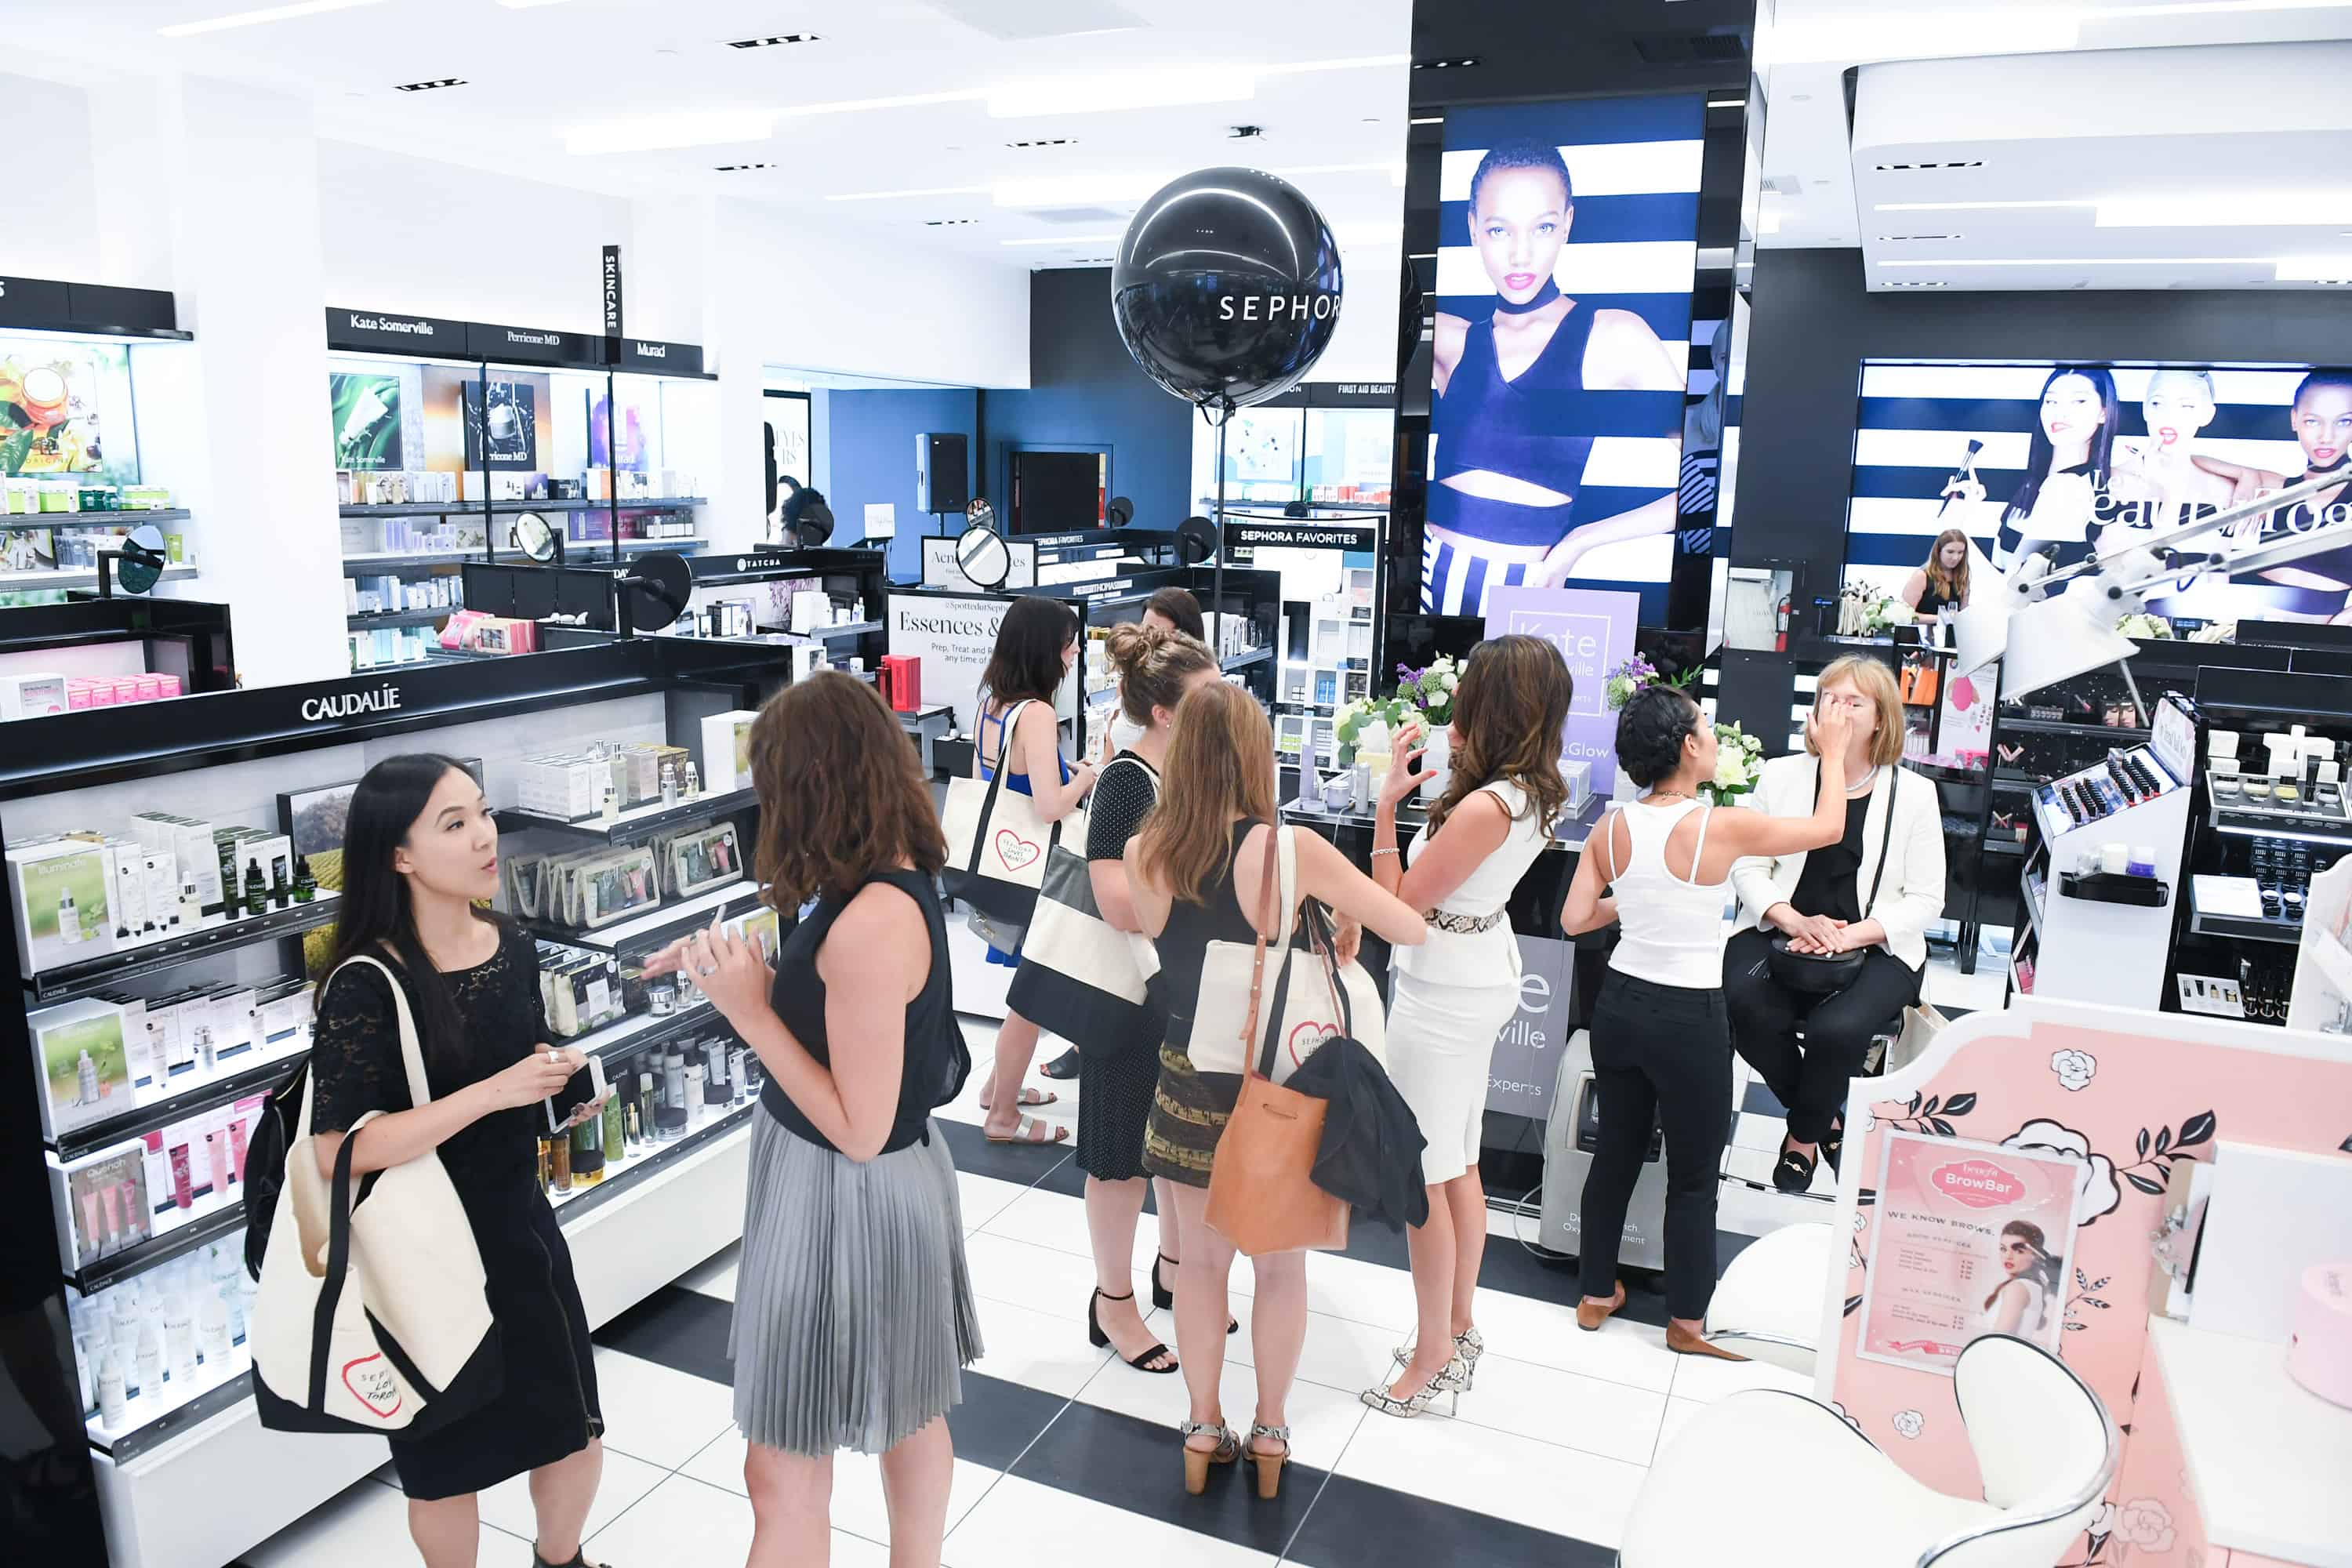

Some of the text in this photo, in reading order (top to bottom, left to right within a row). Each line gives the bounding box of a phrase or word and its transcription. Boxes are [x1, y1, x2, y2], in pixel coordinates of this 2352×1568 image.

[605, 256, 617, 329] SKINCARE
[1219, 295, 1341, 321] SEPHOR
[350, 314, 434, 336] Kate Somerville
[507, 331, 560, 346] Perricone MD
[637, 342, 666, 358] Murad
[1338, 384, 1396, 394] FIRST AID BEAUTY
[480, 452, 528, 462] Prricone MD
[1035, 536, 1058, 546] EPHORA
[1241, 530, 1357, 544] SEPHORA FAVORITES
[746, 559, 781, 568] TATCHA
[931, 551, 956, 564] Acn
[900, 611, 1000, 637] Essences &
[931, 643, 949, 653] Prep,
[951, 644, 969, 653] Treat
[945, 655, 987, 665] any time of
[1568, 661, 1594, 677] ville
[1498, 1019, 1546, 1048] ville
[1945, 1173, 2013, 1193] BrowBar
[1888, 1211, 1907, 1220] WE
[1911, 1214, 1947, 1225] KNOW
